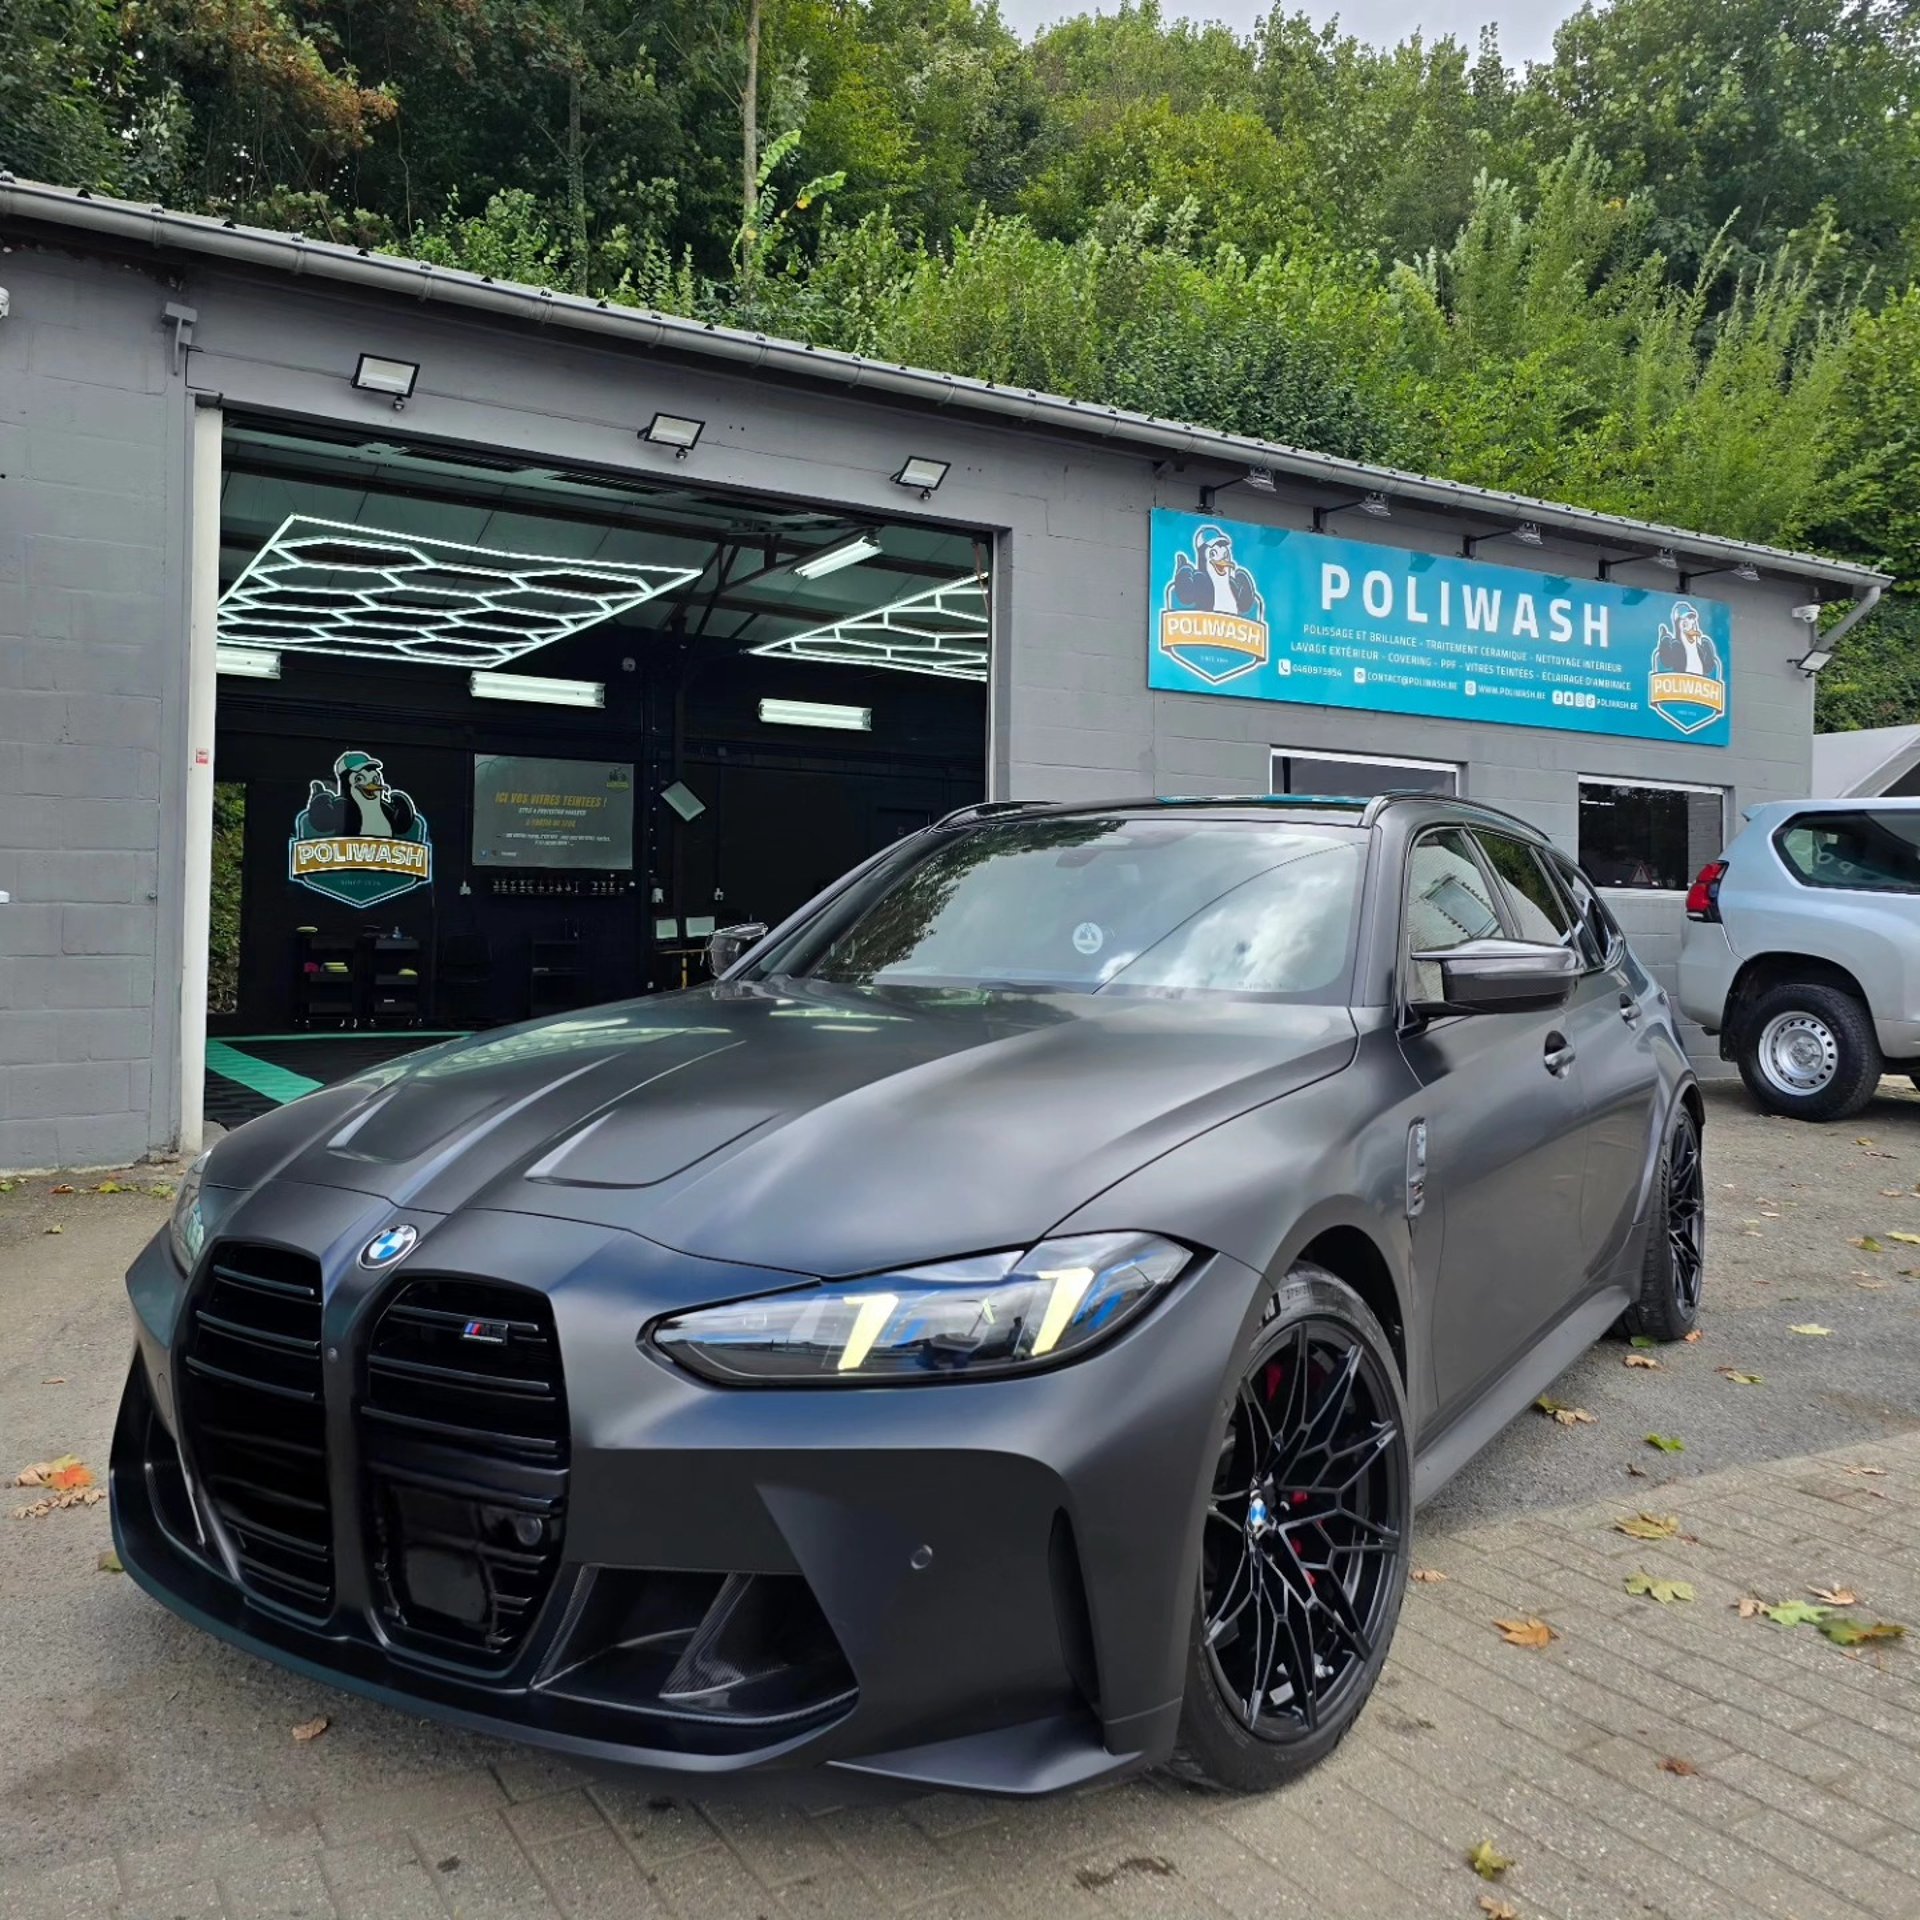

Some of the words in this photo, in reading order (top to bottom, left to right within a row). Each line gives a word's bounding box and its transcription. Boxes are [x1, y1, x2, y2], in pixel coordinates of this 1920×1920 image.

[1321, 562, 1609, 648] POLIWASH
[1167, 617, 1261, 646] POLIWASH
[1303, 624, 1354, 639] POLISSAGE
[1356, 629, 1366, 640] ET
[1370, 631, 1417, 648] BRILLANCE
[1425, 639, 1478, 655] TRAITEMENT
[1536, 654, 1580, 668] NETTOYAGE
[1290, 641, 1327, 655] LAVAGE
[1387, 652, 1432, 667] COVERING
[1440, 658, 1457, 669] PPF
[1464, 662, 1494, 674] VITRES
[1655, 678, 1719, 700] POLIWASH
[297, 843, 424, 867] POLIWASH
